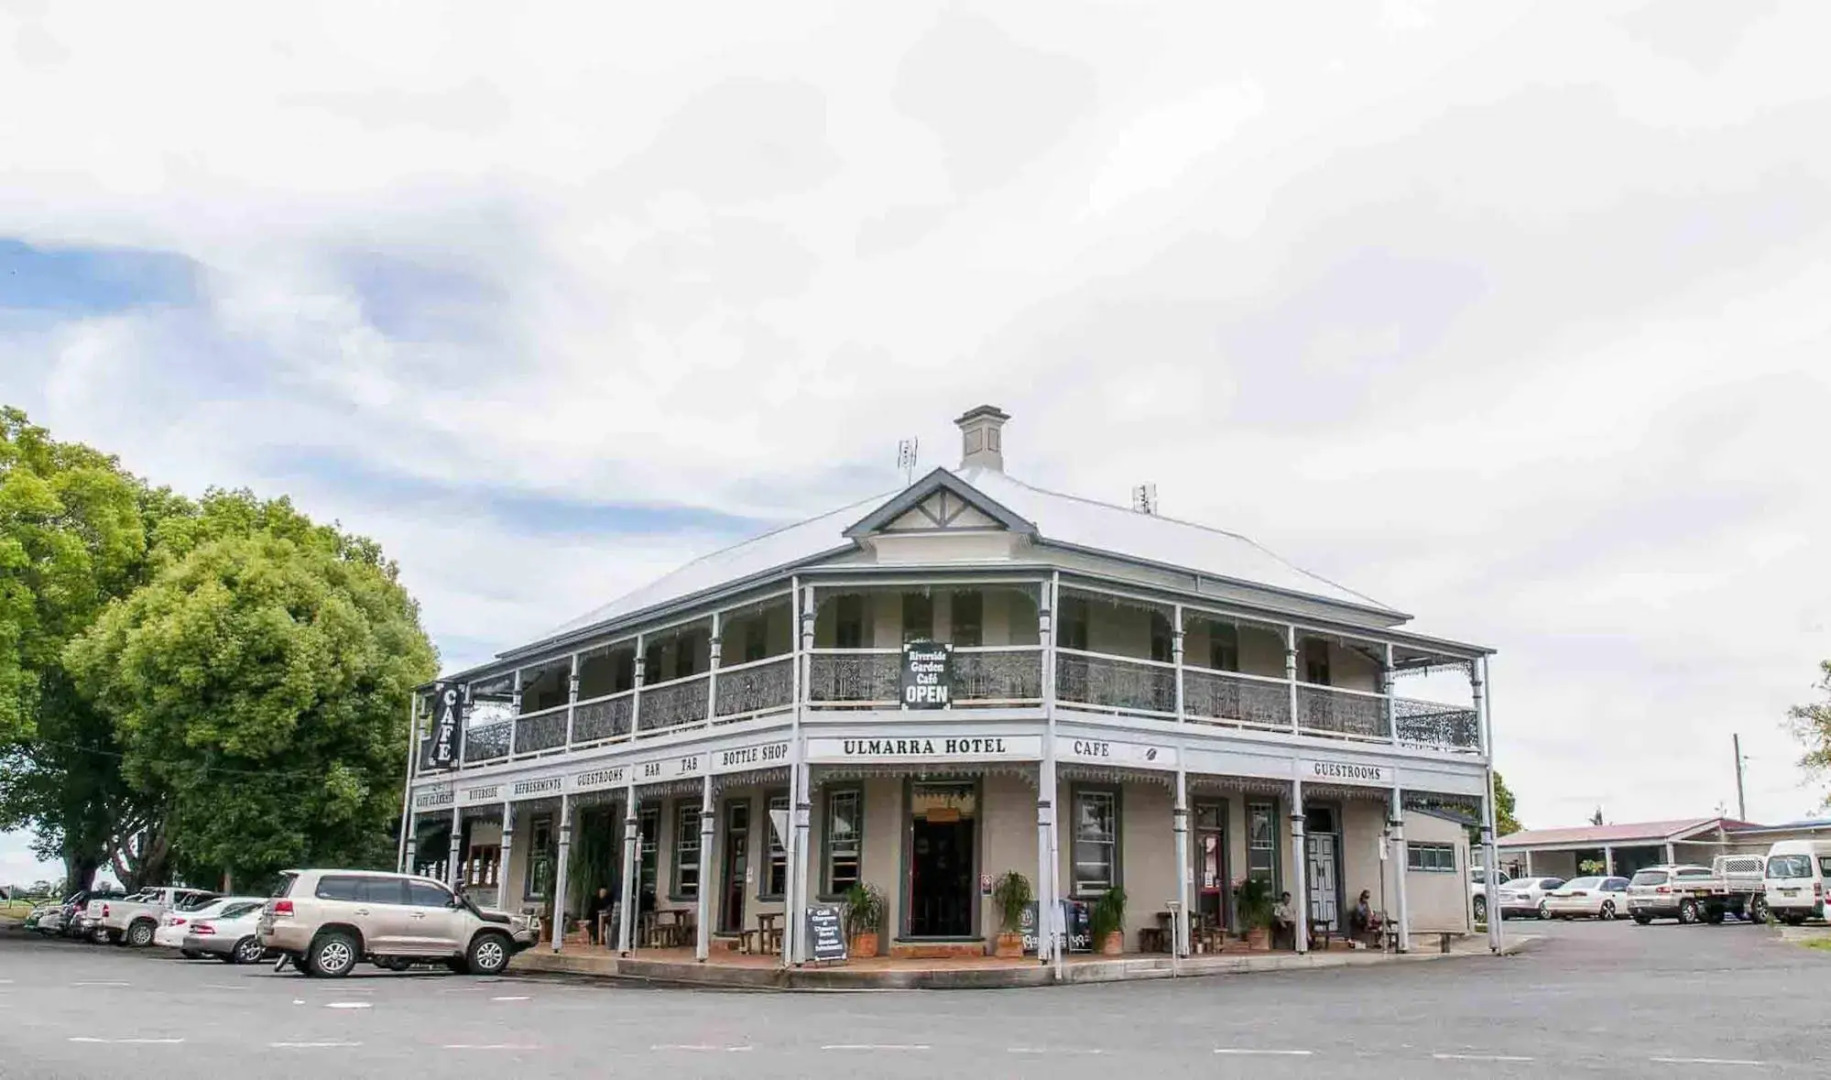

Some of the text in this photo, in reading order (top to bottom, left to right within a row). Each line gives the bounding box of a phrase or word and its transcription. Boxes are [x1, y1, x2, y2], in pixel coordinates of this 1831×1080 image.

[909, 651, 946, 660] Riverside
[911, 661, 944, 672] Garden
[916, 672, 938, 684] Café
[906, 685, 948, 703] OPEN
[437, 689, 457, 761] CAFE
[722, 743, 789, 766] BOTTLE SHOP
[843, 738, 1006, 755] ULMARRA HOTEL
[1074, 740, 1110, 757] CAFE
[645, 757, 698, 777] BAR TAB
[1314, 762, 1381, 780] GUESTROOMS
[514, 778, 562, 795] REFRESHMENTS
[577, 769, 623, 787] GUESTROOMS
